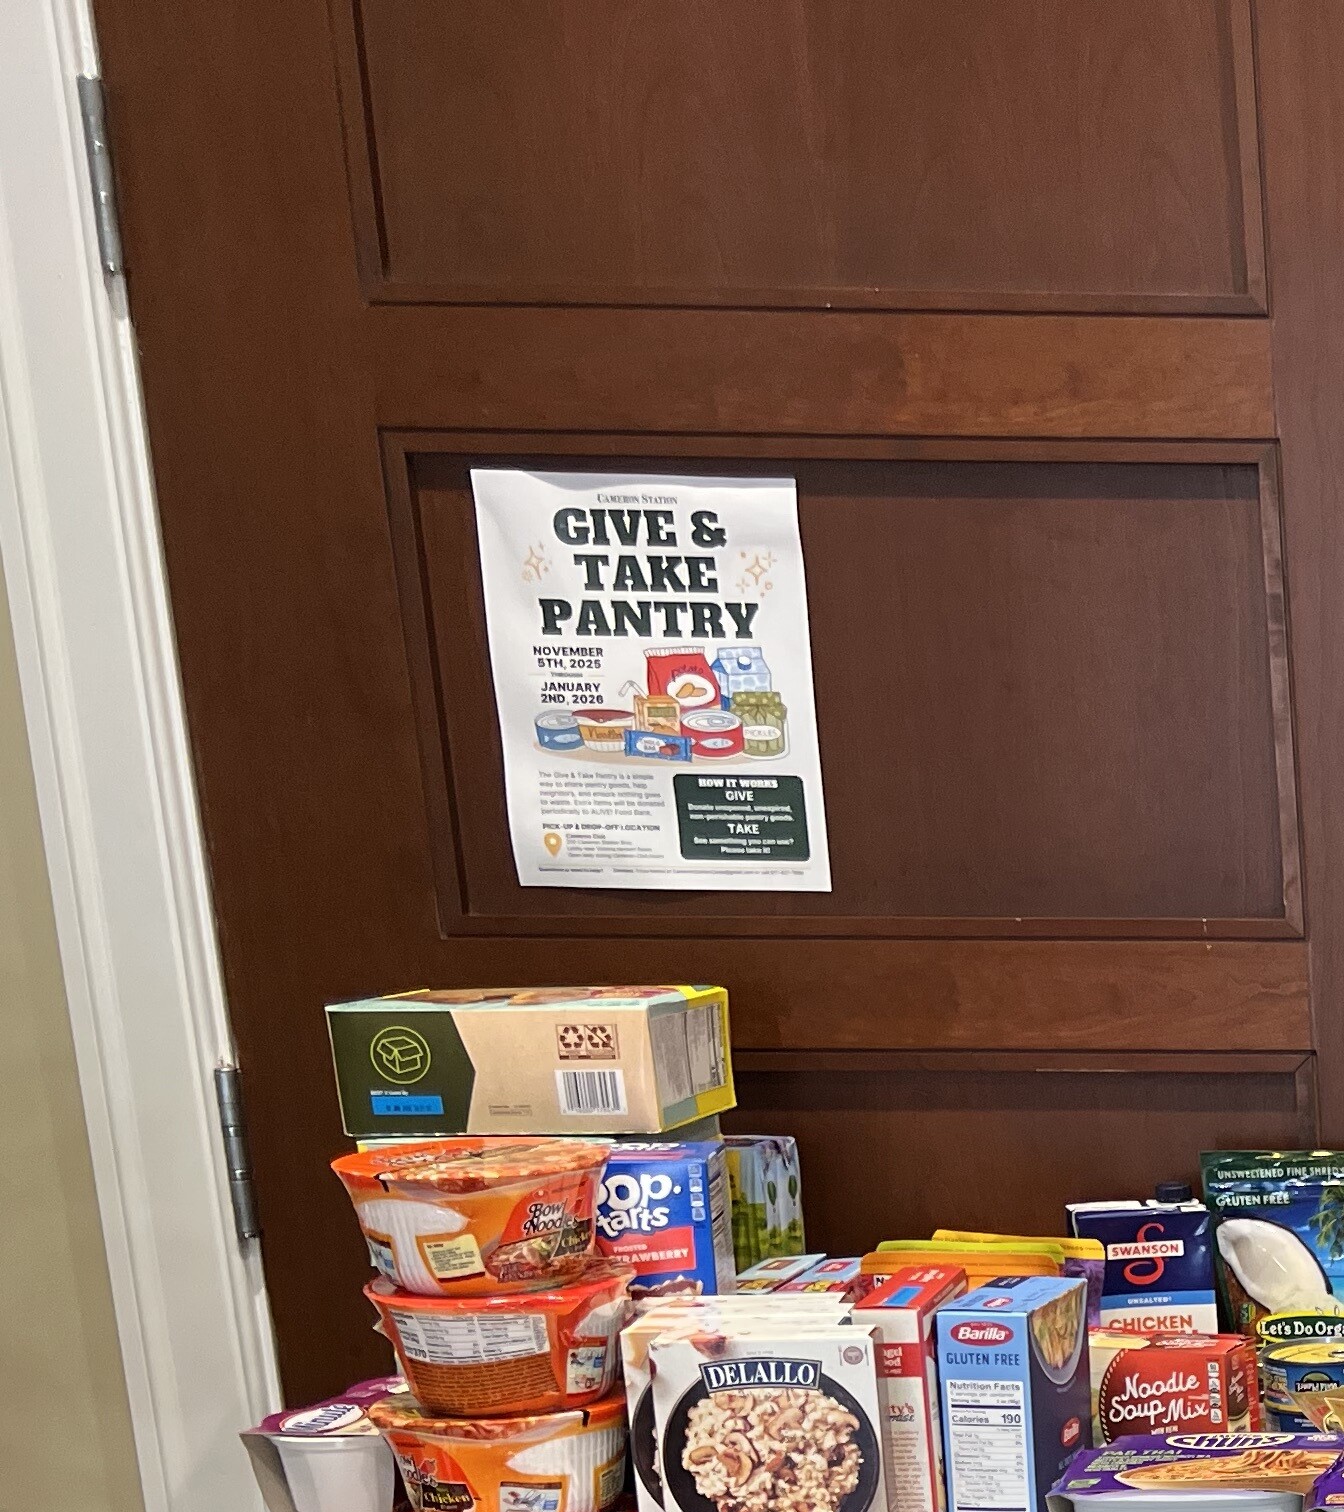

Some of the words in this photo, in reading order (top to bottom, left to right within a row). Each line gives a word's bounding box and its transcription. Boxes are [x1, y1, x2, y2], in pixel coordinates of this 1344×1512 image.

[554, 508, 676, 546] GIVE
[691, 511, 726, 548] &
[574, 554, 718, 593] TAKE
[538, 598, 758, 638] PANTRY
[533, 646, 603, 656] NOVEMBER
[538, 658, 567, 670] 5TH,
[570, 659, 601, 669] 2025
[541, 682, 600, 692] JANUARY
[541, 694, 569, 705] 2ND,
[572, 695, 603, 704] 2026
[725, 791, 754, 801] GIVE
[727, 823, 759, 834] TAKE
[1218, 1168, 1284, 1180] UNSWEETENED
[1287, 1167, 1307, 1177] FINE
[1216, 1195, 1260, 1207] GLUTEN
[1262, 1193, 1290, 1205] FREE
[1112, 1243, 1179, 1256] SWANSON
[1109, 1315, 1193, 1330] CHICKEN
[1260, 1321, 1292, 1336] Let's
[1294, 1322, 1312, 1335] Do
[958, 1327, 1010, 1341] Barilla
[947, 1353, 989, 1365] GLUTEN
[994, 1353, 1020, 1366] FREE
[707, 1364, 815, 1387] DELALLO
[950, 1382, 991, 1391] Nutrition
[994, 1382, 1020, 1391] Facts
[1125, 1373, 1200, 1400] Noodle
[1110, 1397, 1165, 1426] Soup
[1162, 1397, 1208, 1424] Mix
[952, 1415, 989, 1424] Calories
[1001, 1414, 1021, 1424] 190
[423, 1492, 470, 1505] Chicken
